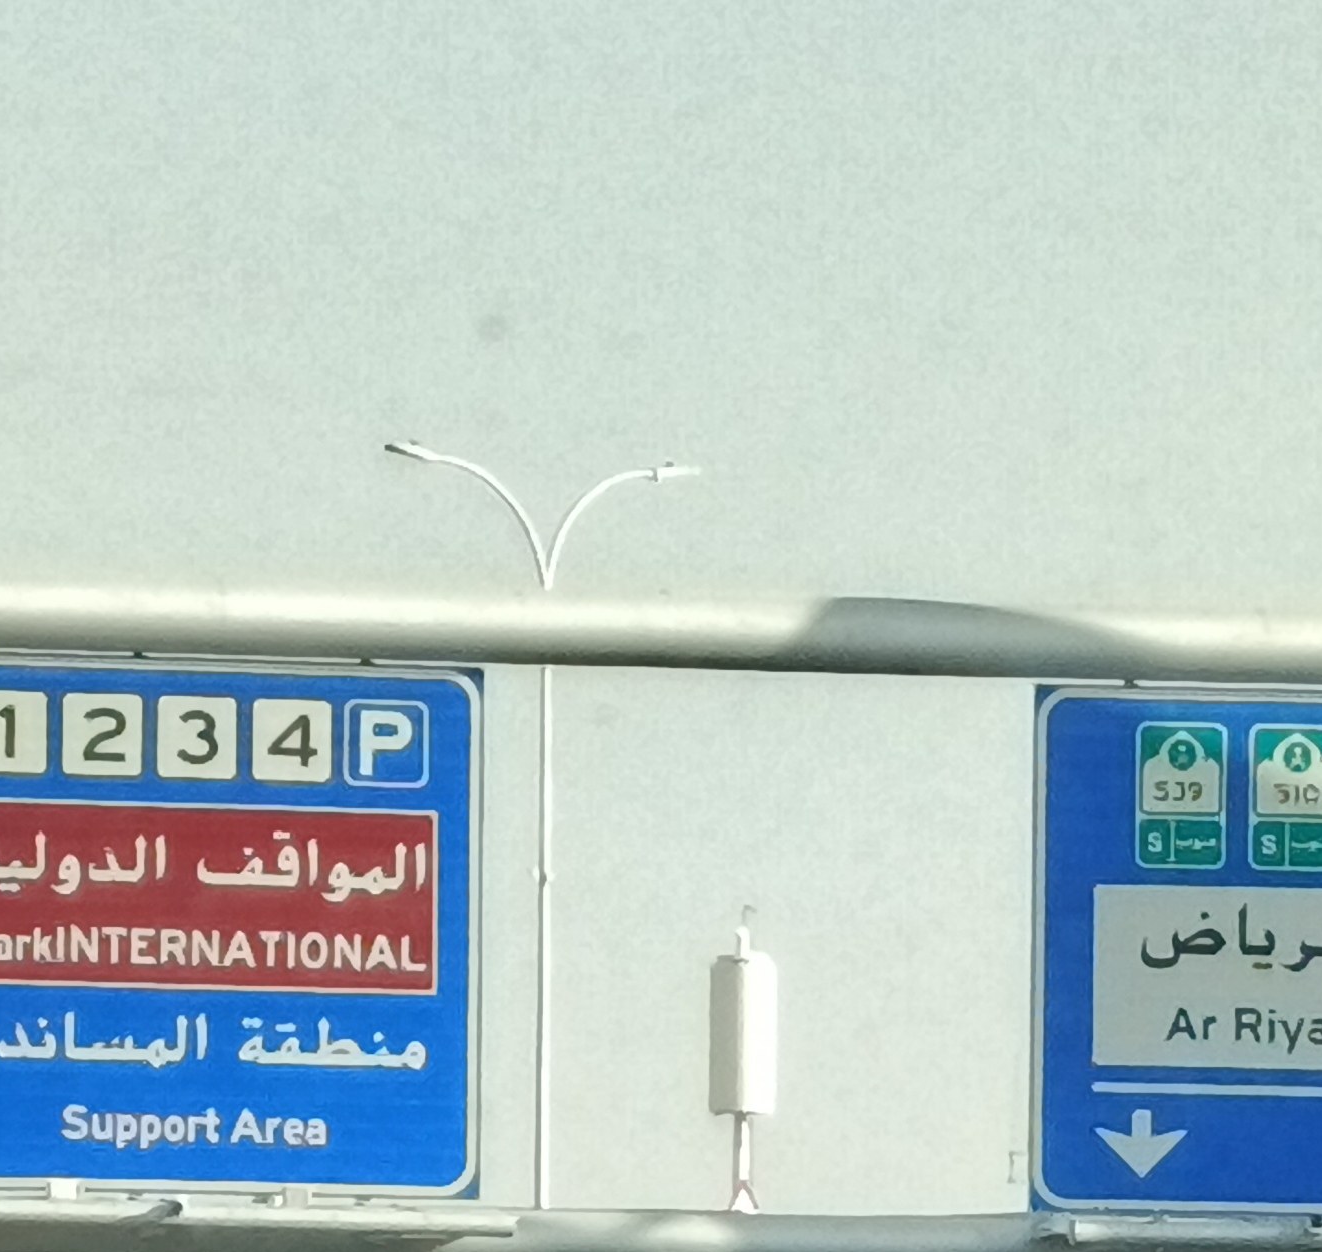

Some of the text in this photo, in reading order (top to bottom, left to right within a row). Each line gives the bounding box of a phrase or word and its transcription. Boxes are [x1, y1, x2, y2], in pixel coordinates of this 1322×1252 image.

[0, 704, 412, 775] 1 2 3 4 P
[1147, 832, 1163, 852] S
[1260, 834, 1277, 854] S
[196, 831, 426, 902] المواقف
[238, 1017, 426, 1069] منطقة
[1165, 1008, 1217, 1042] Ar
[62, 1105, 327, 1148] Support Area
